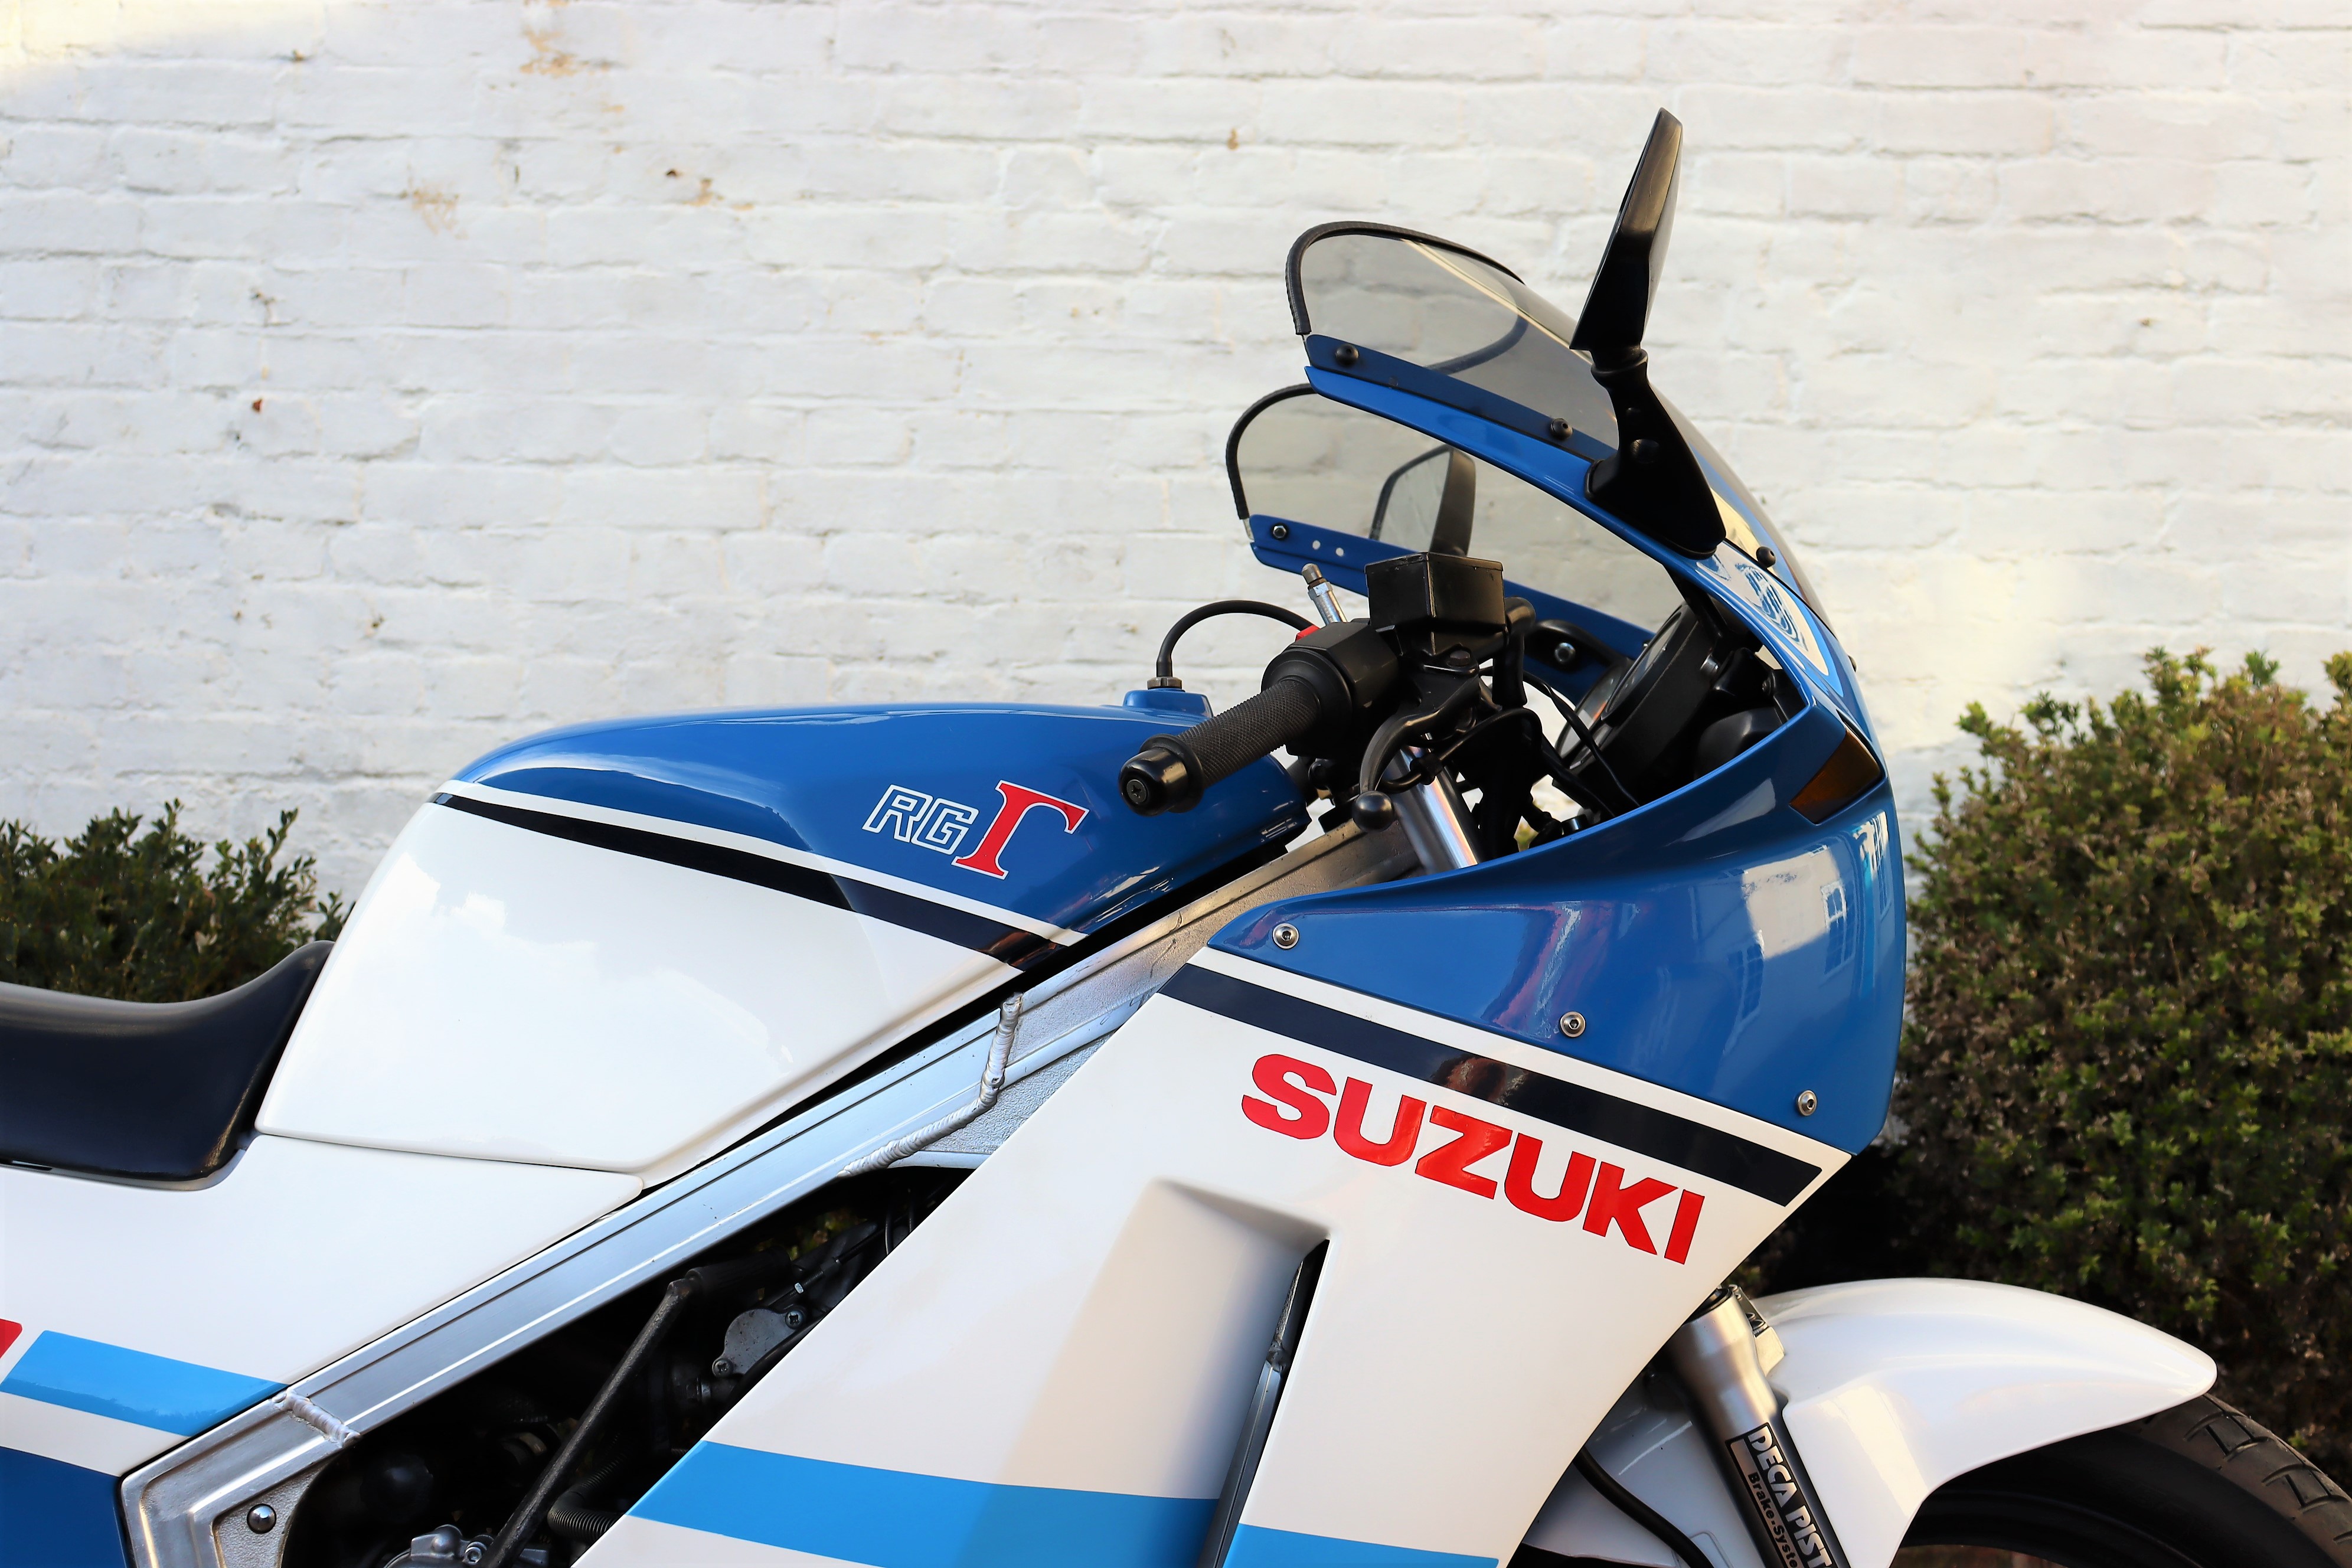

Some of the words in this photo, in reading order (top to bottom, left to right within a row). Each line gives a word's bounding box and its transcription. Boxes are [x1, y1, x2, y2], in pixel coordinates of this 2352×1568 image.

[1242, 1054, 1705, 1265] SUZUKI
[1747, 1425, 1798, 1508] DECA
[1785, 1505, 1832, 1568] PIST
